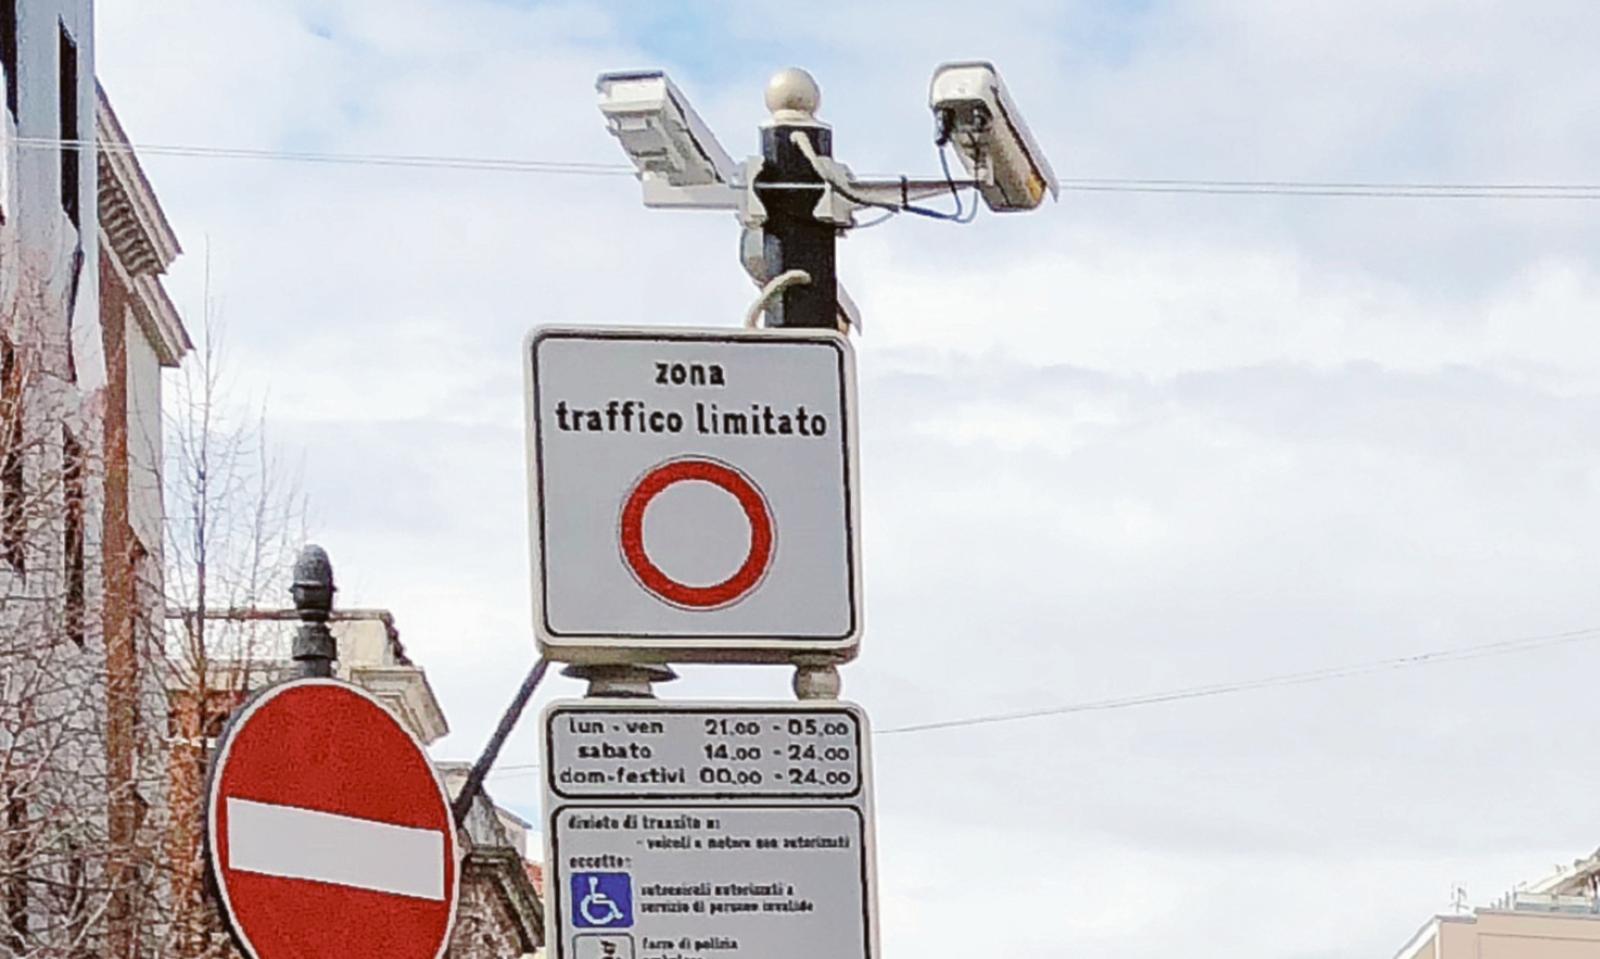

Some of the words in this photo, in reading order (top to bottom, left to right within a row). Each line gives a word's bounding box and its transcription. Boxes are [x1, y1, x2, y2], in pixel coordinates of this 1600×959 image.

[655, 362, 725, 386] zona
[556, 401, 683, 432] traffico
[697, 402, 827, 436] limitato
[569, 718, 604, 734] lun
[626, 721, 664, 734] ven
[704, 719, 761, 735] 21.00
[787, 719, 850, 736] 05.00
[577, 743, 652, 759] sabato
[704, 745, 762, 761] 14.00
[788, 745, 850, 761] 24.00
[559, 767, 686, 784] dom-festivi
[700, 768, 763, 785] 00.00
[788, 769, 851, 785] 24.00
[623, 814, 638, 829] di
